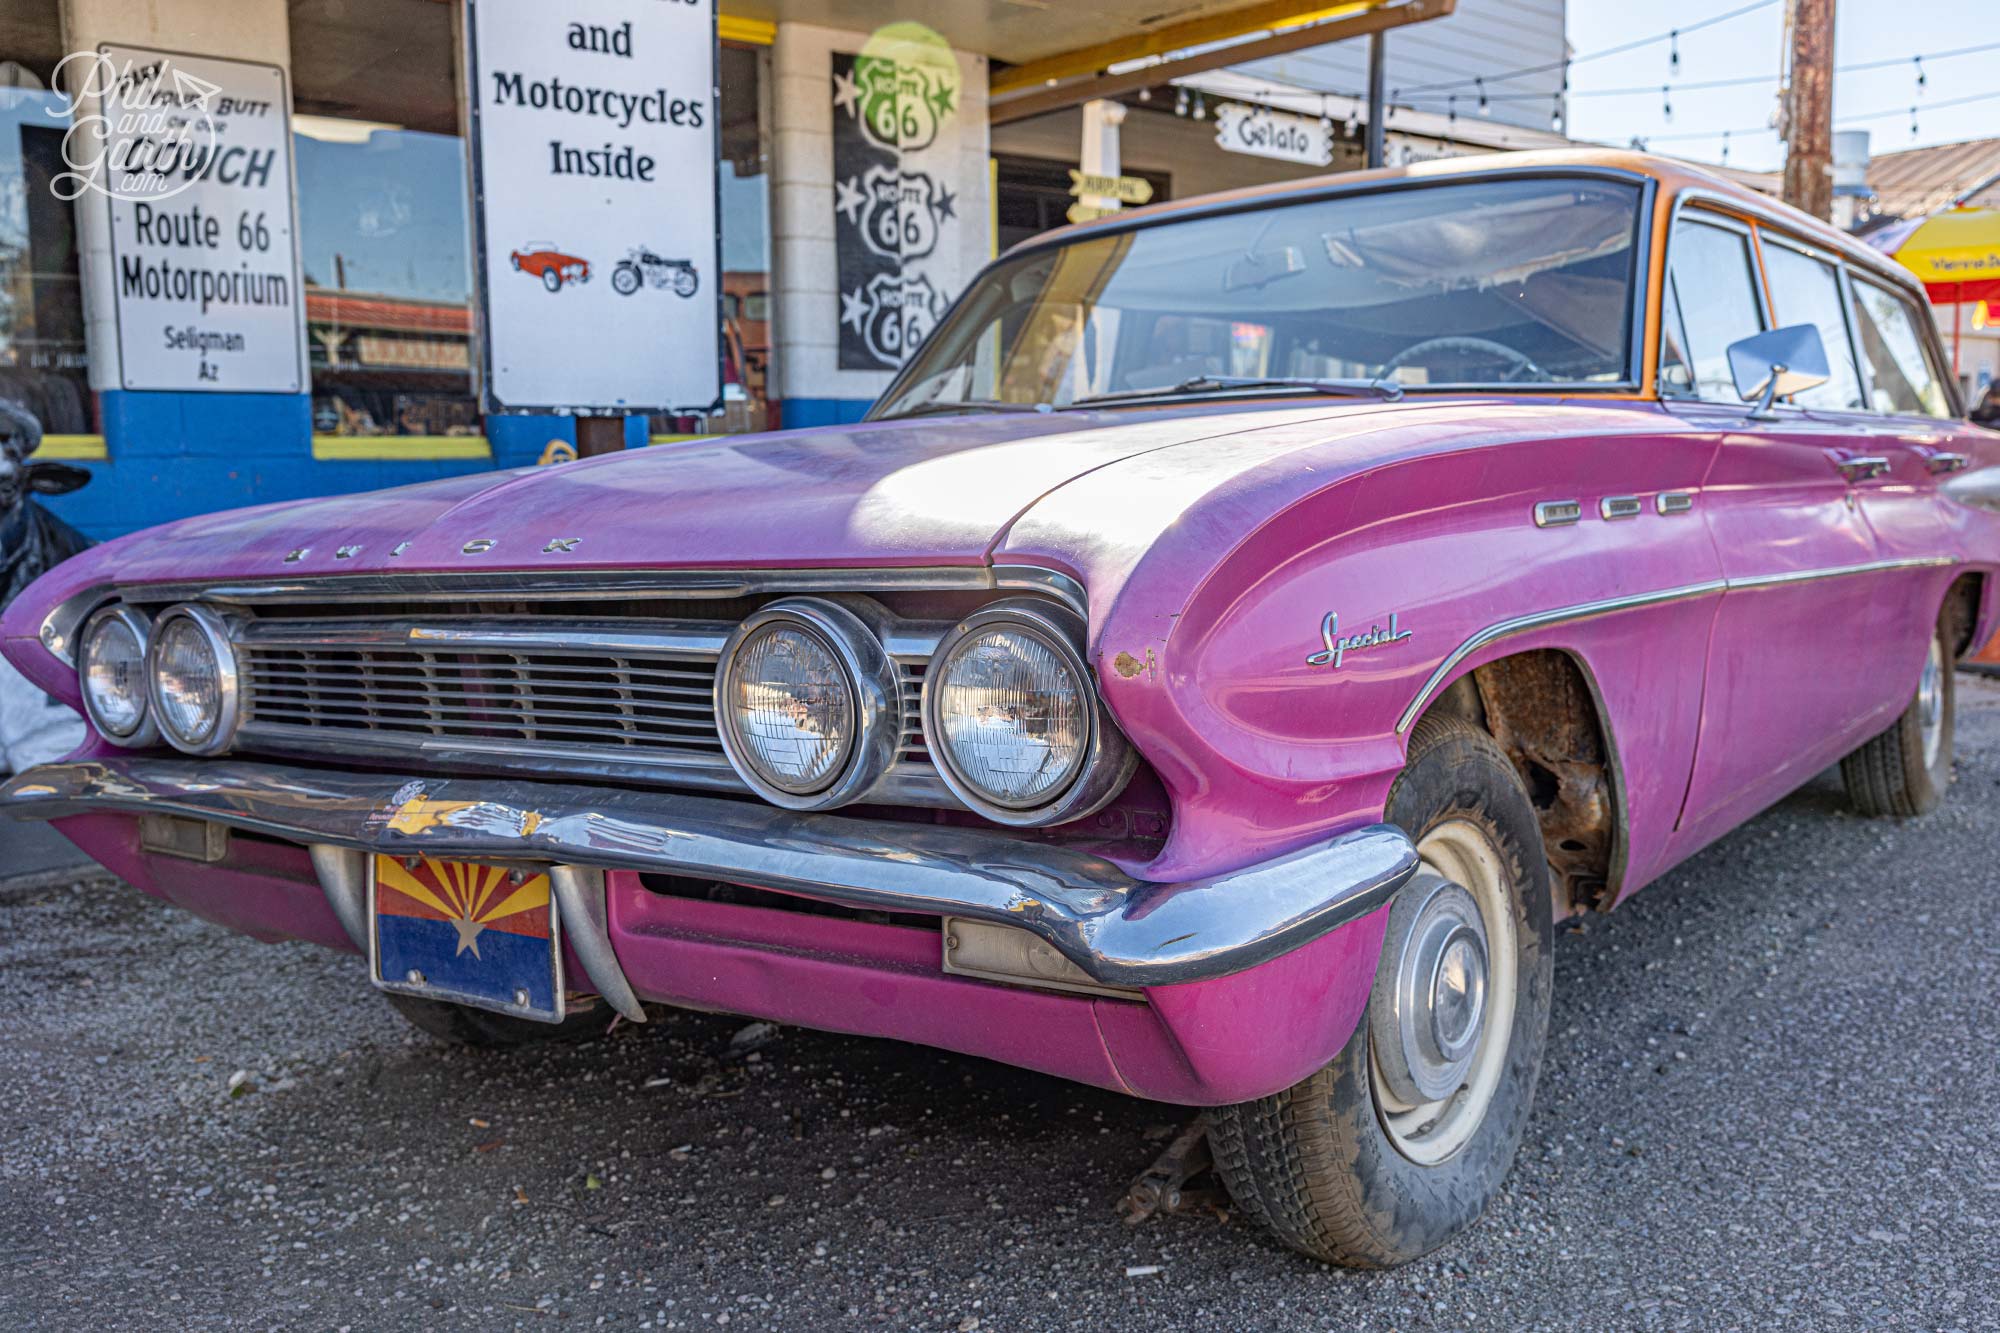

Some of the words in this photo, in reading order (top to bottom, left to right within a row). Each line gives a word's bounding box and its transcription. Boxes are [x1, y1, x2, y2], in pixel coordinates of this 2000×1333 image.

[568, 22, 633, 58] and
[216, 97, 271, 118] BUTT
[491, 70, 704, 128] Motorcycles
[877, 100, 918, 139] 66
[549, 141, 655, 181] Inside
[876, 183, 921, 203] ROUTE
[135, 201, 221, 249] Route
[238, 210, 270, 252] 66
[879, 209, 920, 245] 66
[121, 254, 289, 316] Motorporium
[879, 288, 925, 307] ROUTE
[163, 325, 246, 357] Seligman
[880, 312, 922, 351] 66
[198, 360, 219, 382] Az
[1306, 610, 1413, 668] Special
